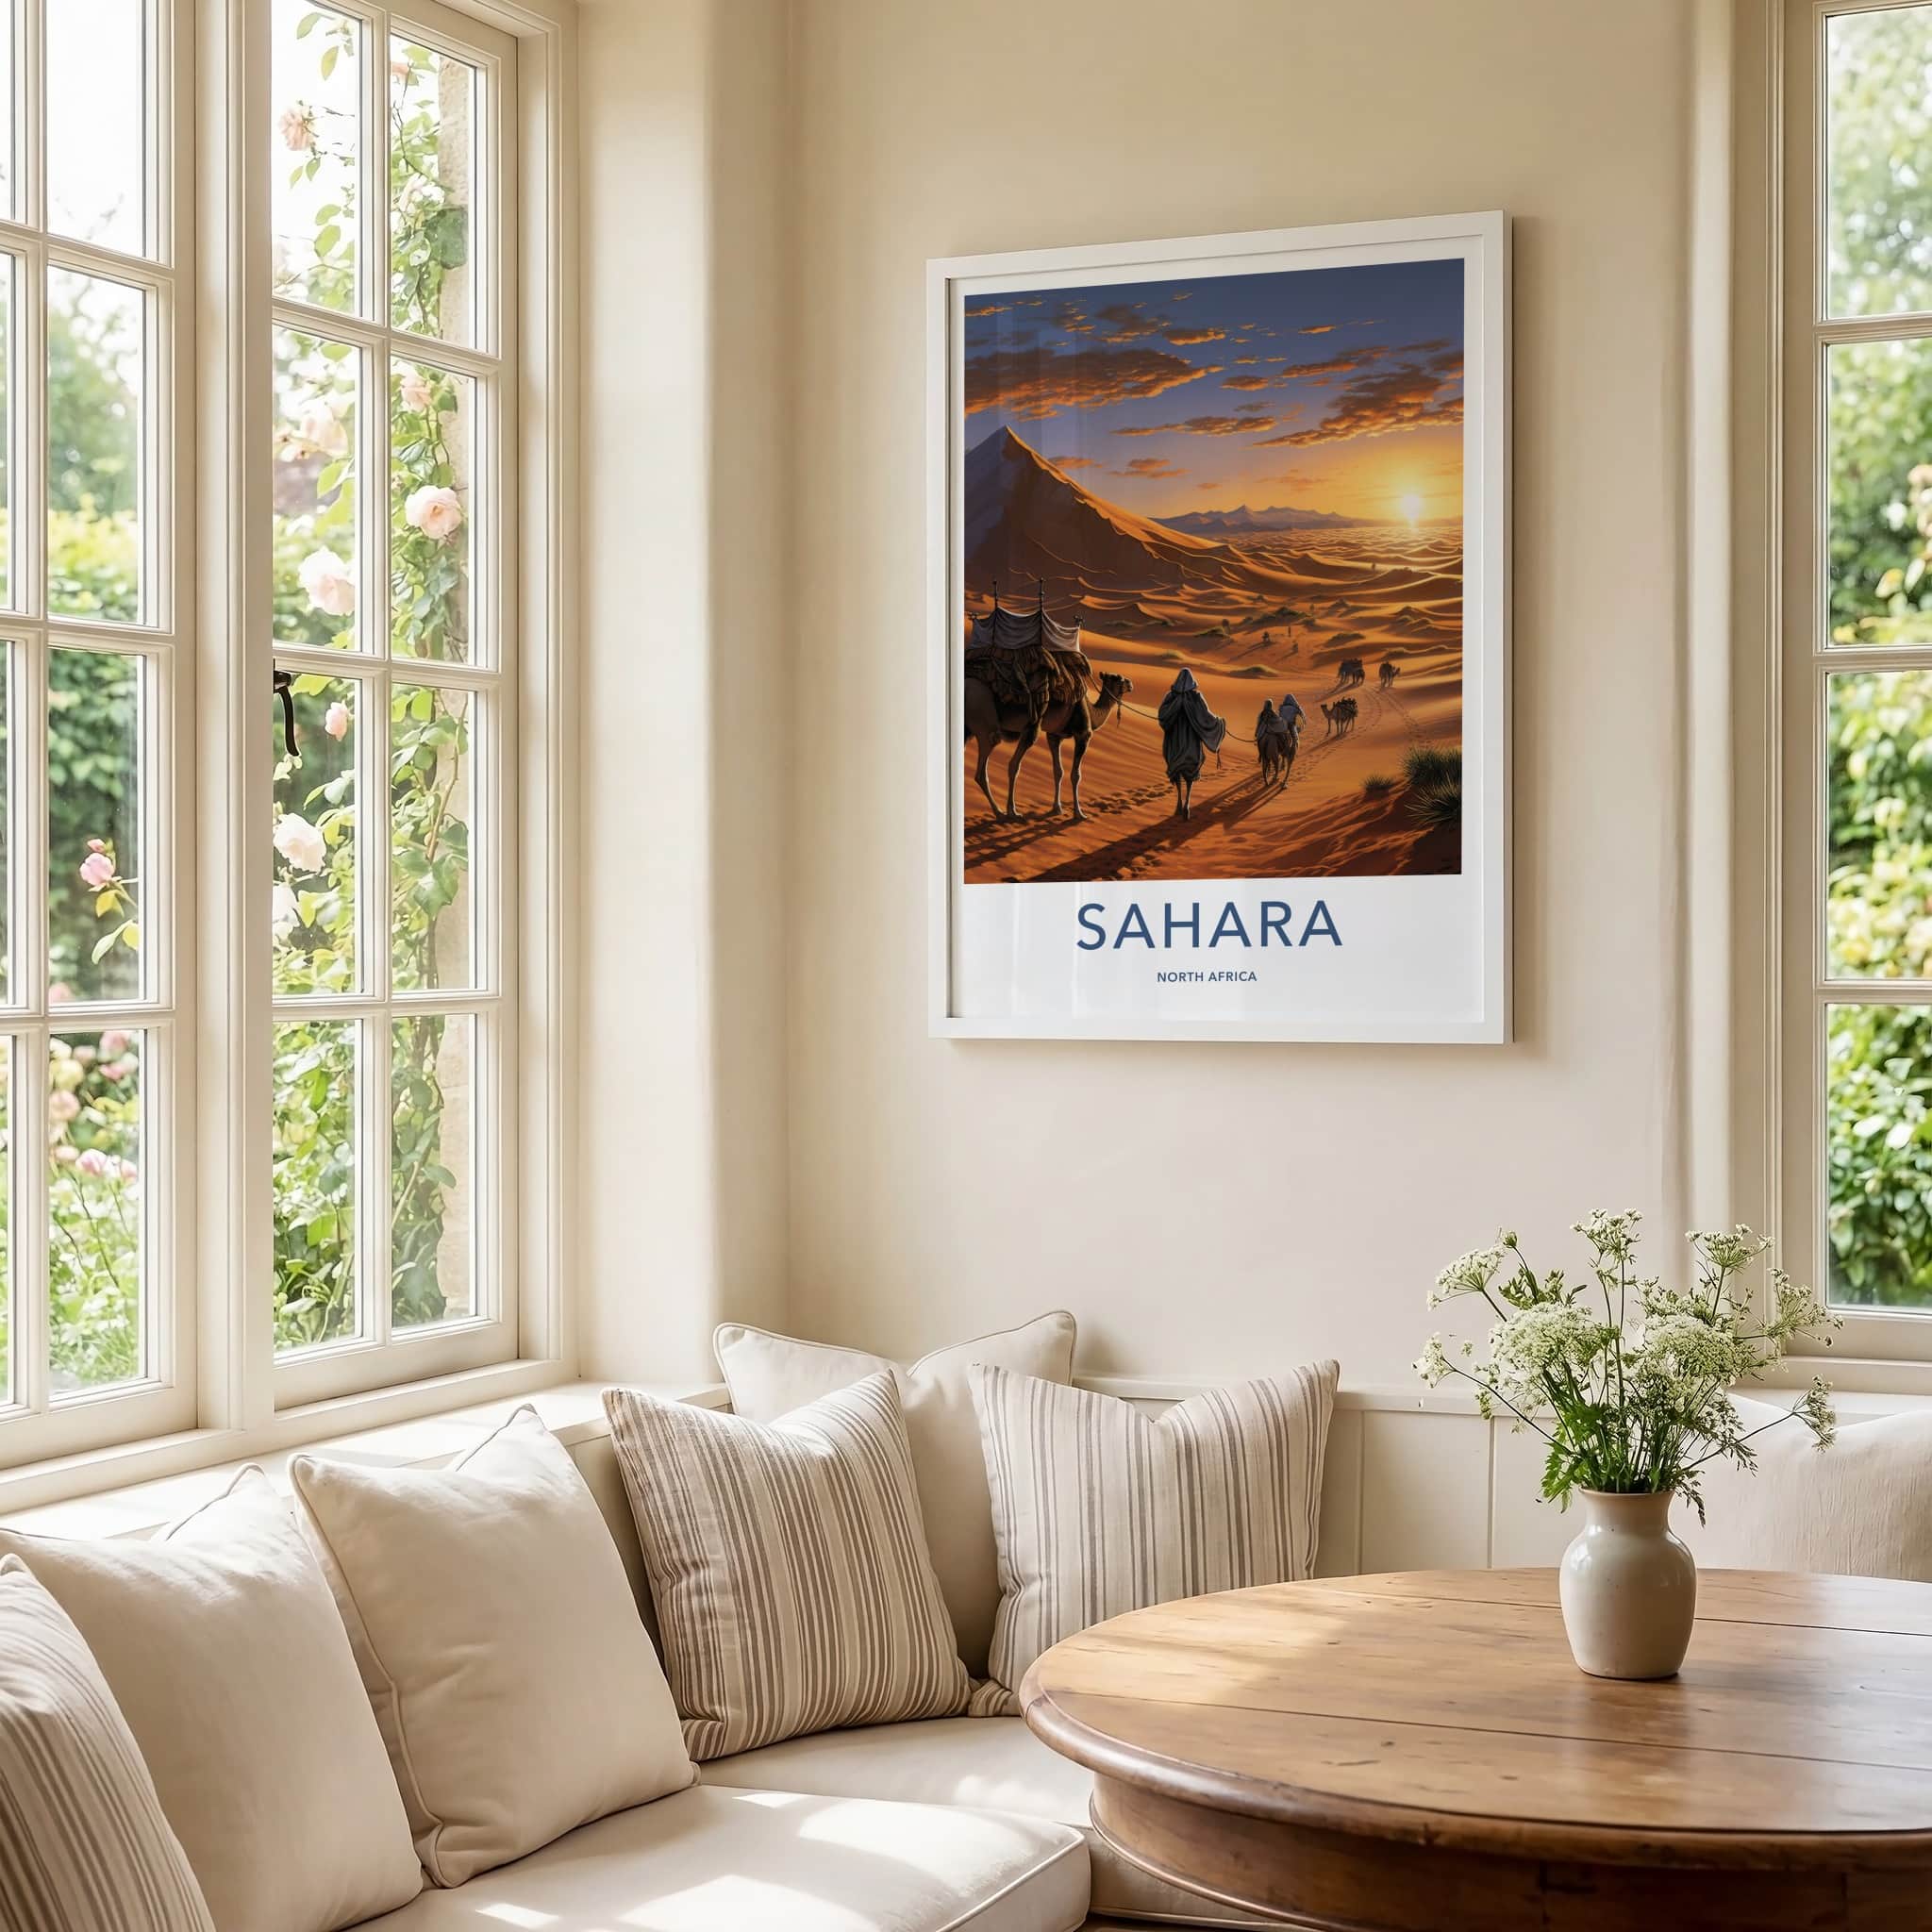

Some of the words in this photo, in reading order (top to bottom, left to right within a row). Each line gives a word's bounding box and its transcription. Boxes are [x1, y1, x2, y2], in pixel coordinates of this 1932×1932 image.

[1076, 900, 1343, 950] SAHARA
[1157, 971, 1204, 983] NORTH
[1208, 971, 1257, 983] AFRICA
